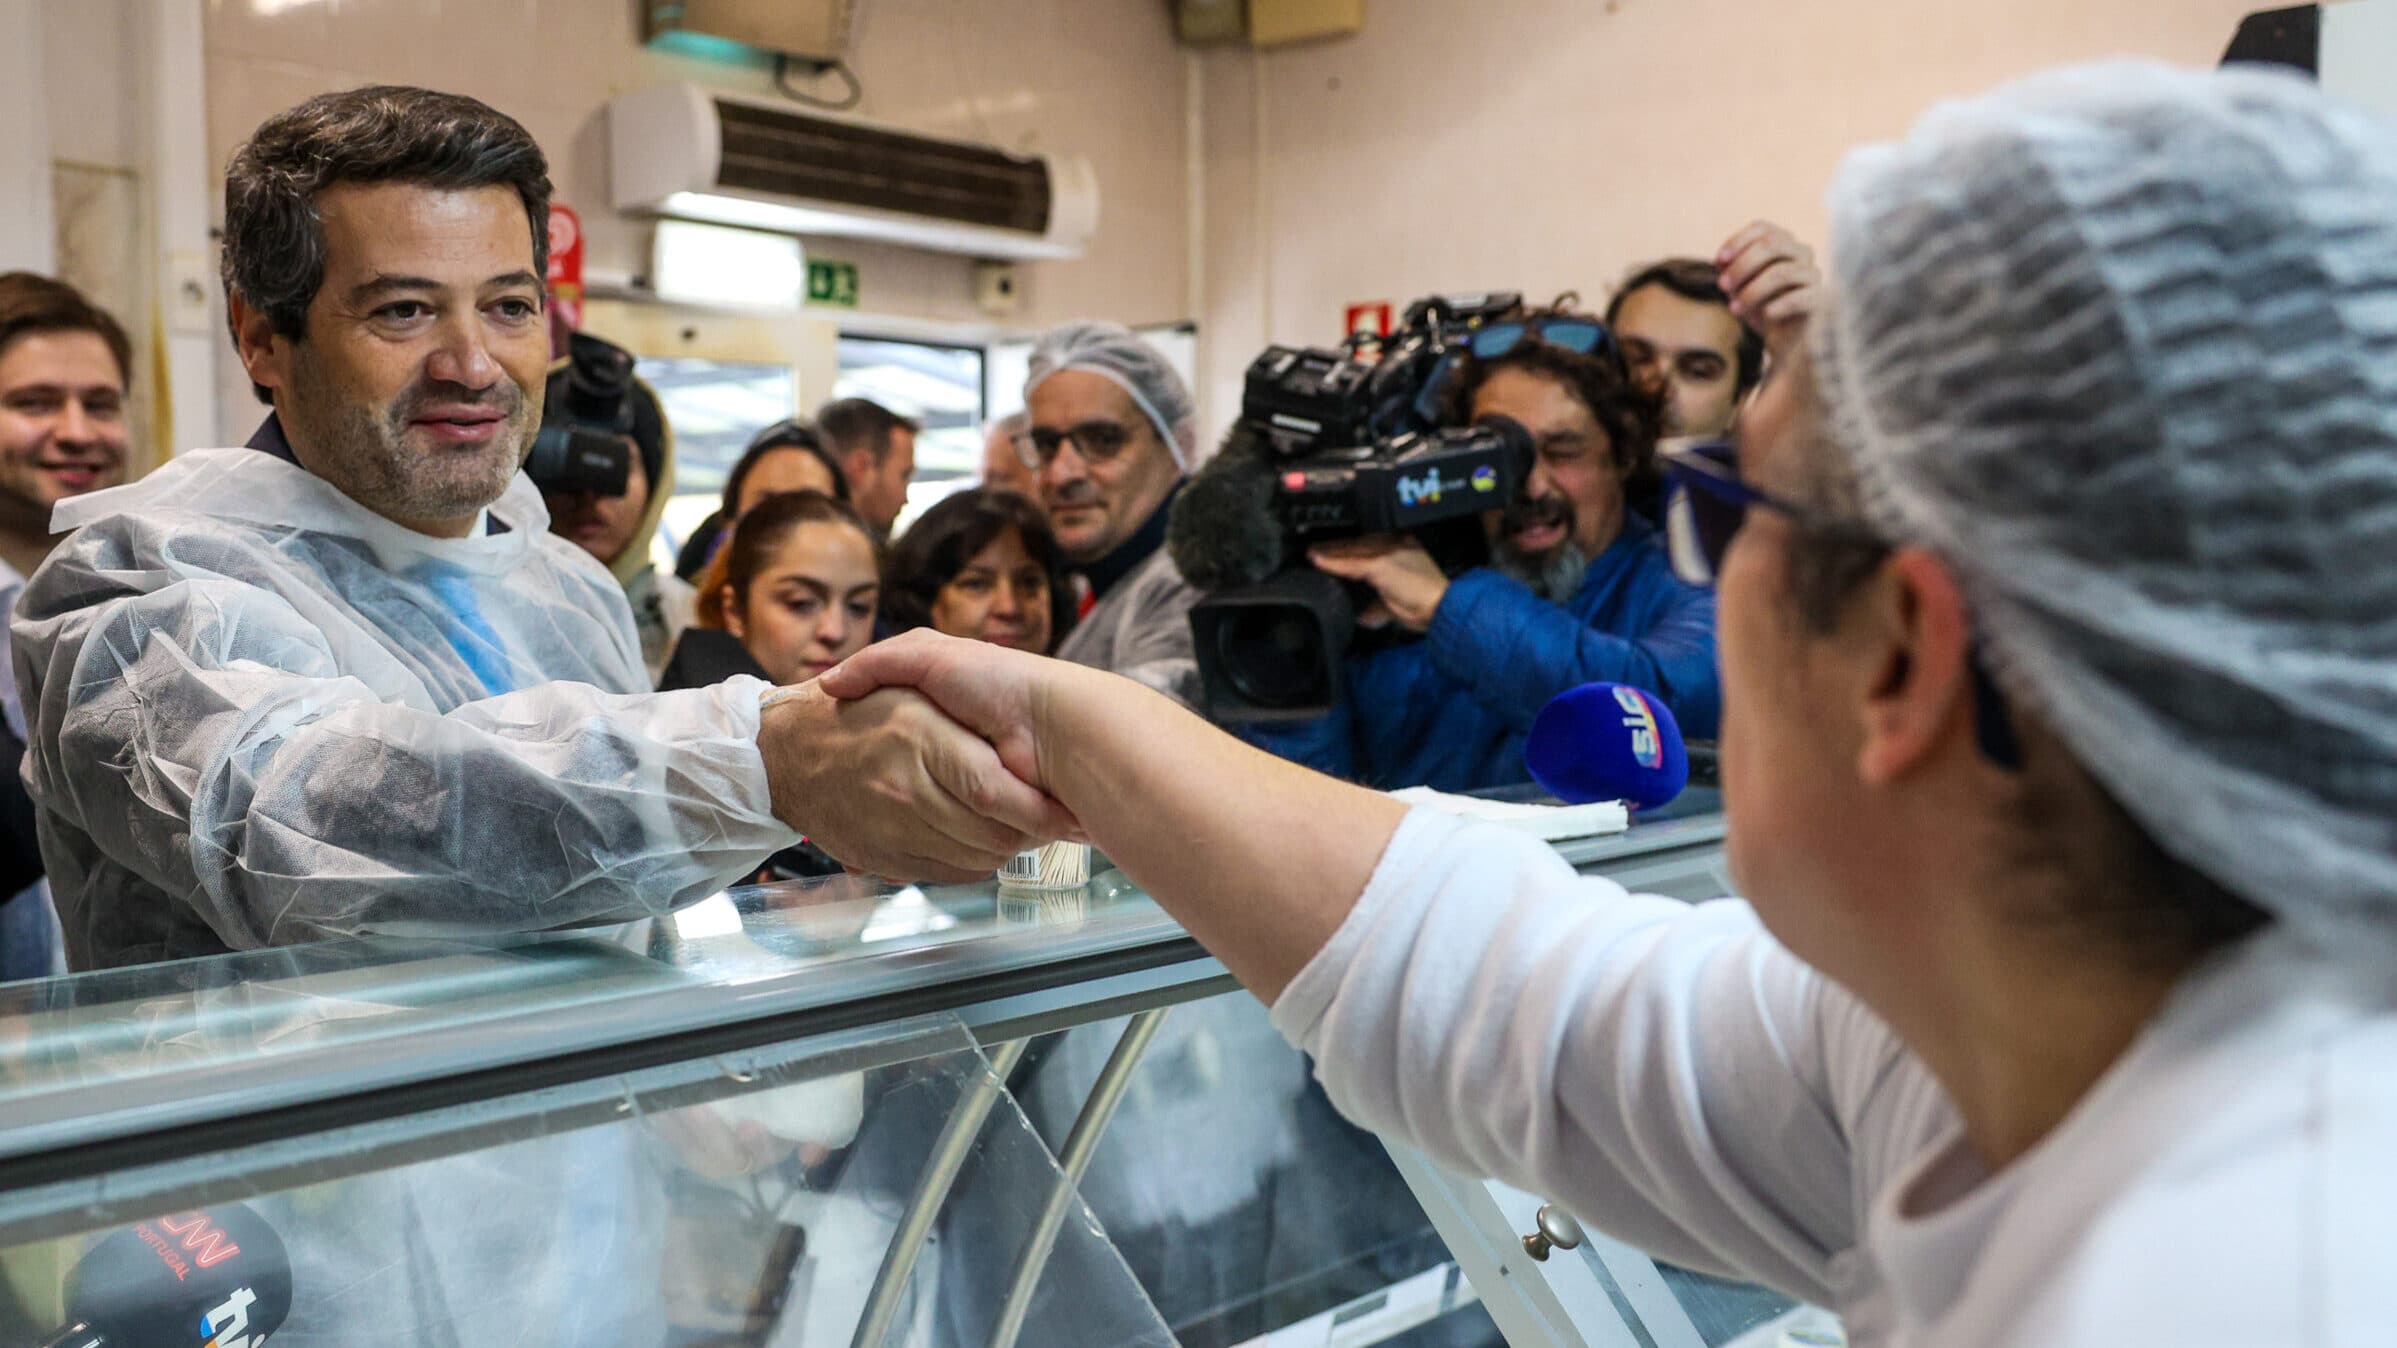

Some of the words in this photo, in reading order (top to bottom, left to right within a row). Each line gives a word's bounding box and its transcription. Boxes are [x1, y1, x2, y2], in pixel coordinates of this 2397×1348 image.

[1396, 467, 1440, 506] tvi
[1612, 686, 1661, 768] SIC
[200, 1287, 266, 1348] tv
